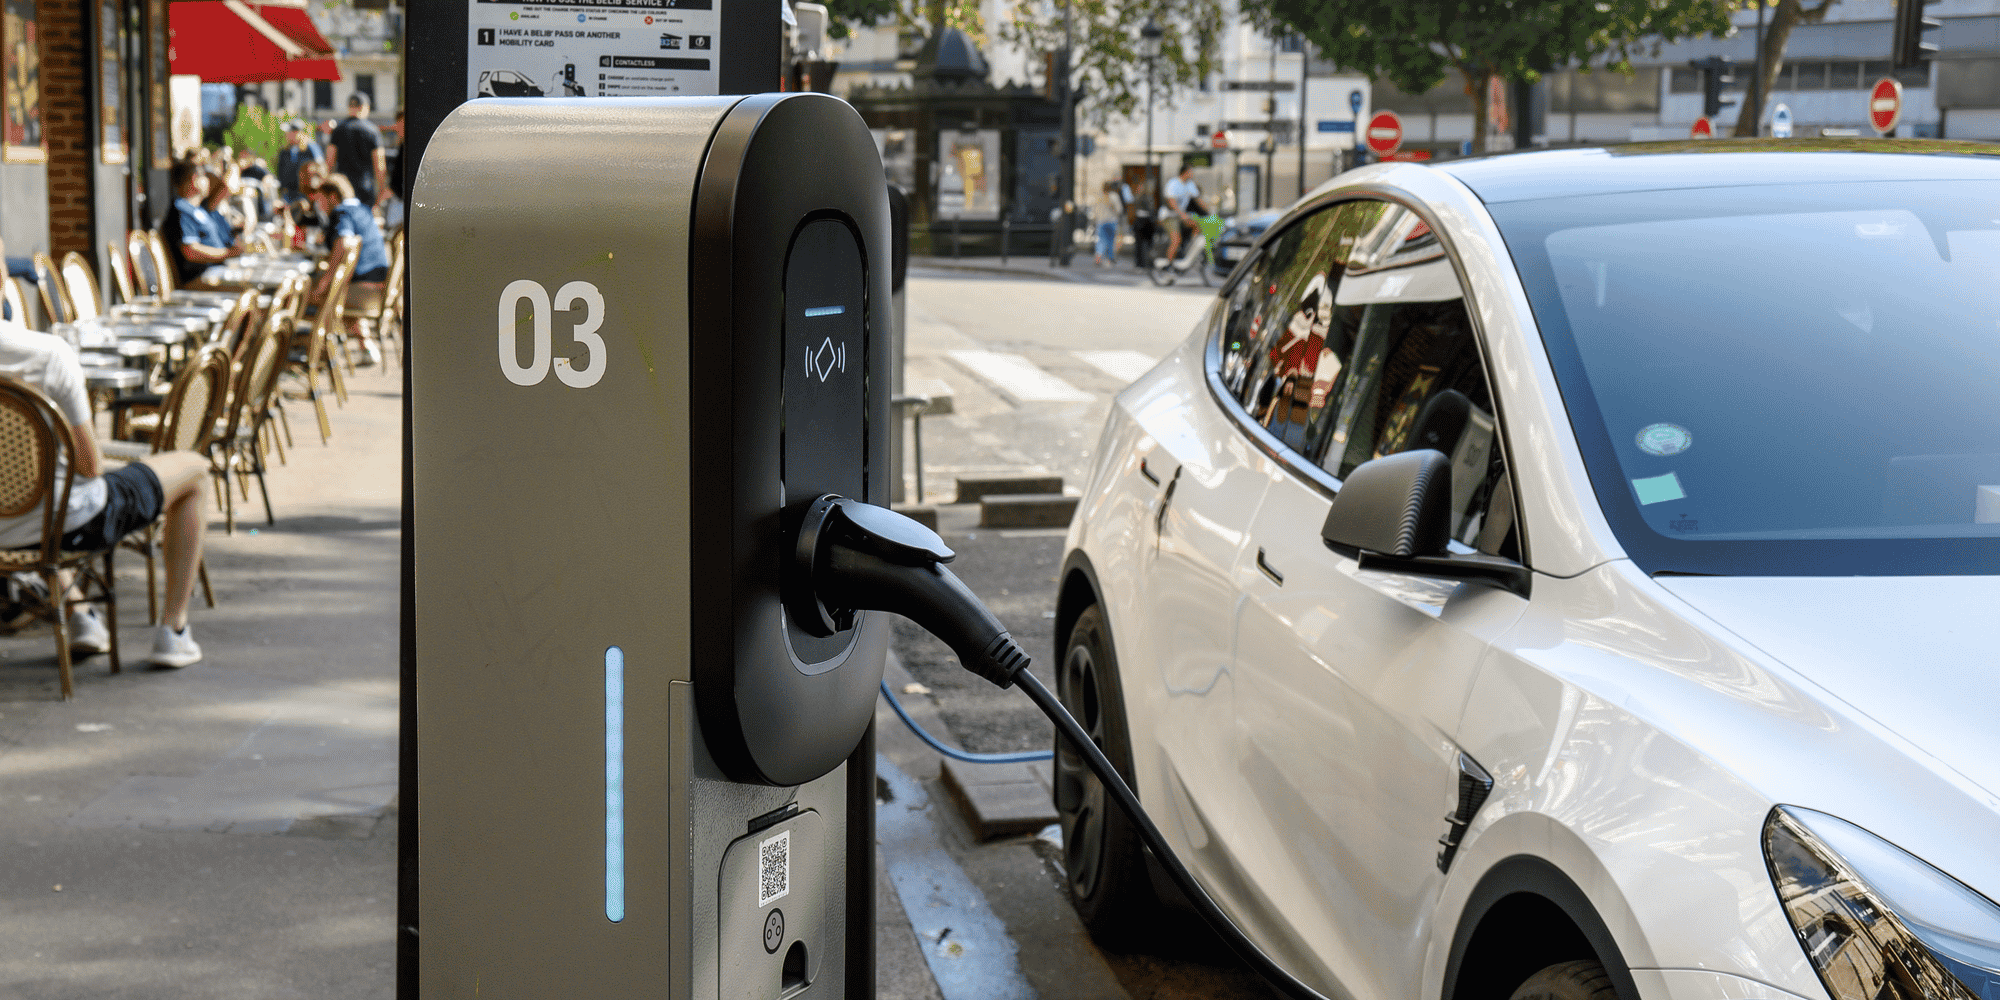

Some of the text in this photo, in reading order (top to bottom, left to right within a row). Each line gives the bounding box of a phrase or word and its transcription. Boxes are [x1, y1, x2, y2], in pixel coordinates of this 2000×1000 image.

[483, 31, 490, 44] 1
[555, 30, 573, 38] PASS
[587, 31, 621, 39] ANOTHER
[498, 280, 607, 389] 03
